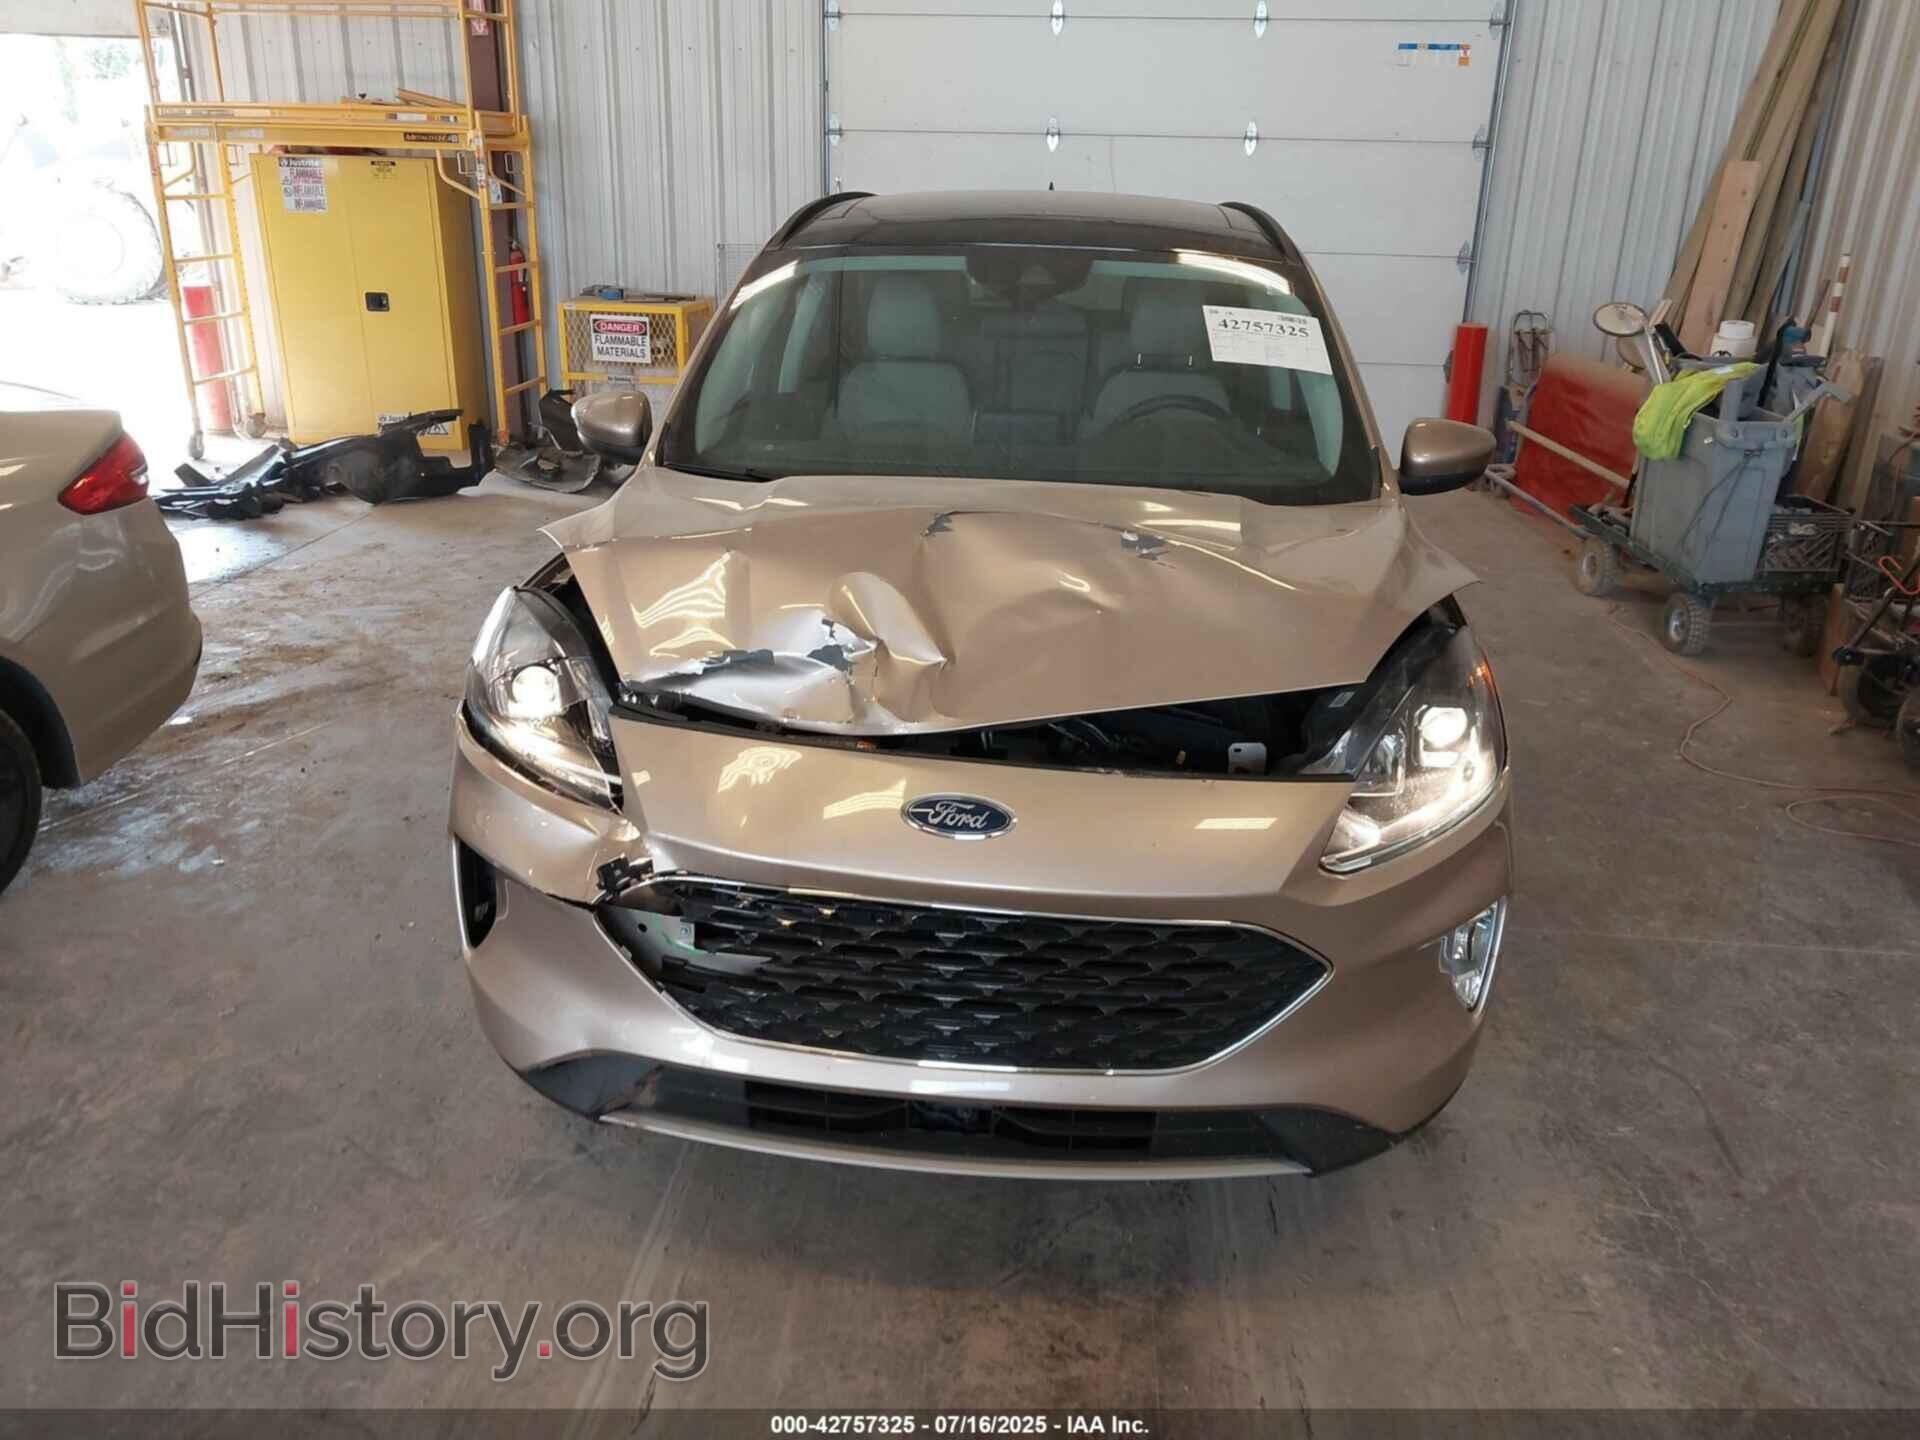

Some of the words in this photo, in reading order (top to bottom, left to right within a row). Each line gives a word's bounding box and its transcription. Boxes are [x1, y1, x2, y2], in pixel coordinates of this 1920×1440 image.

[600, 321, 640, 332] DANGER
[1218, 318, 1310, 338] 42757325
[594, 334, 647, 347] FLAMMABLE
[597, 345, 646, 358] MATERIALS
[910, 801, 991, 829] Ford
